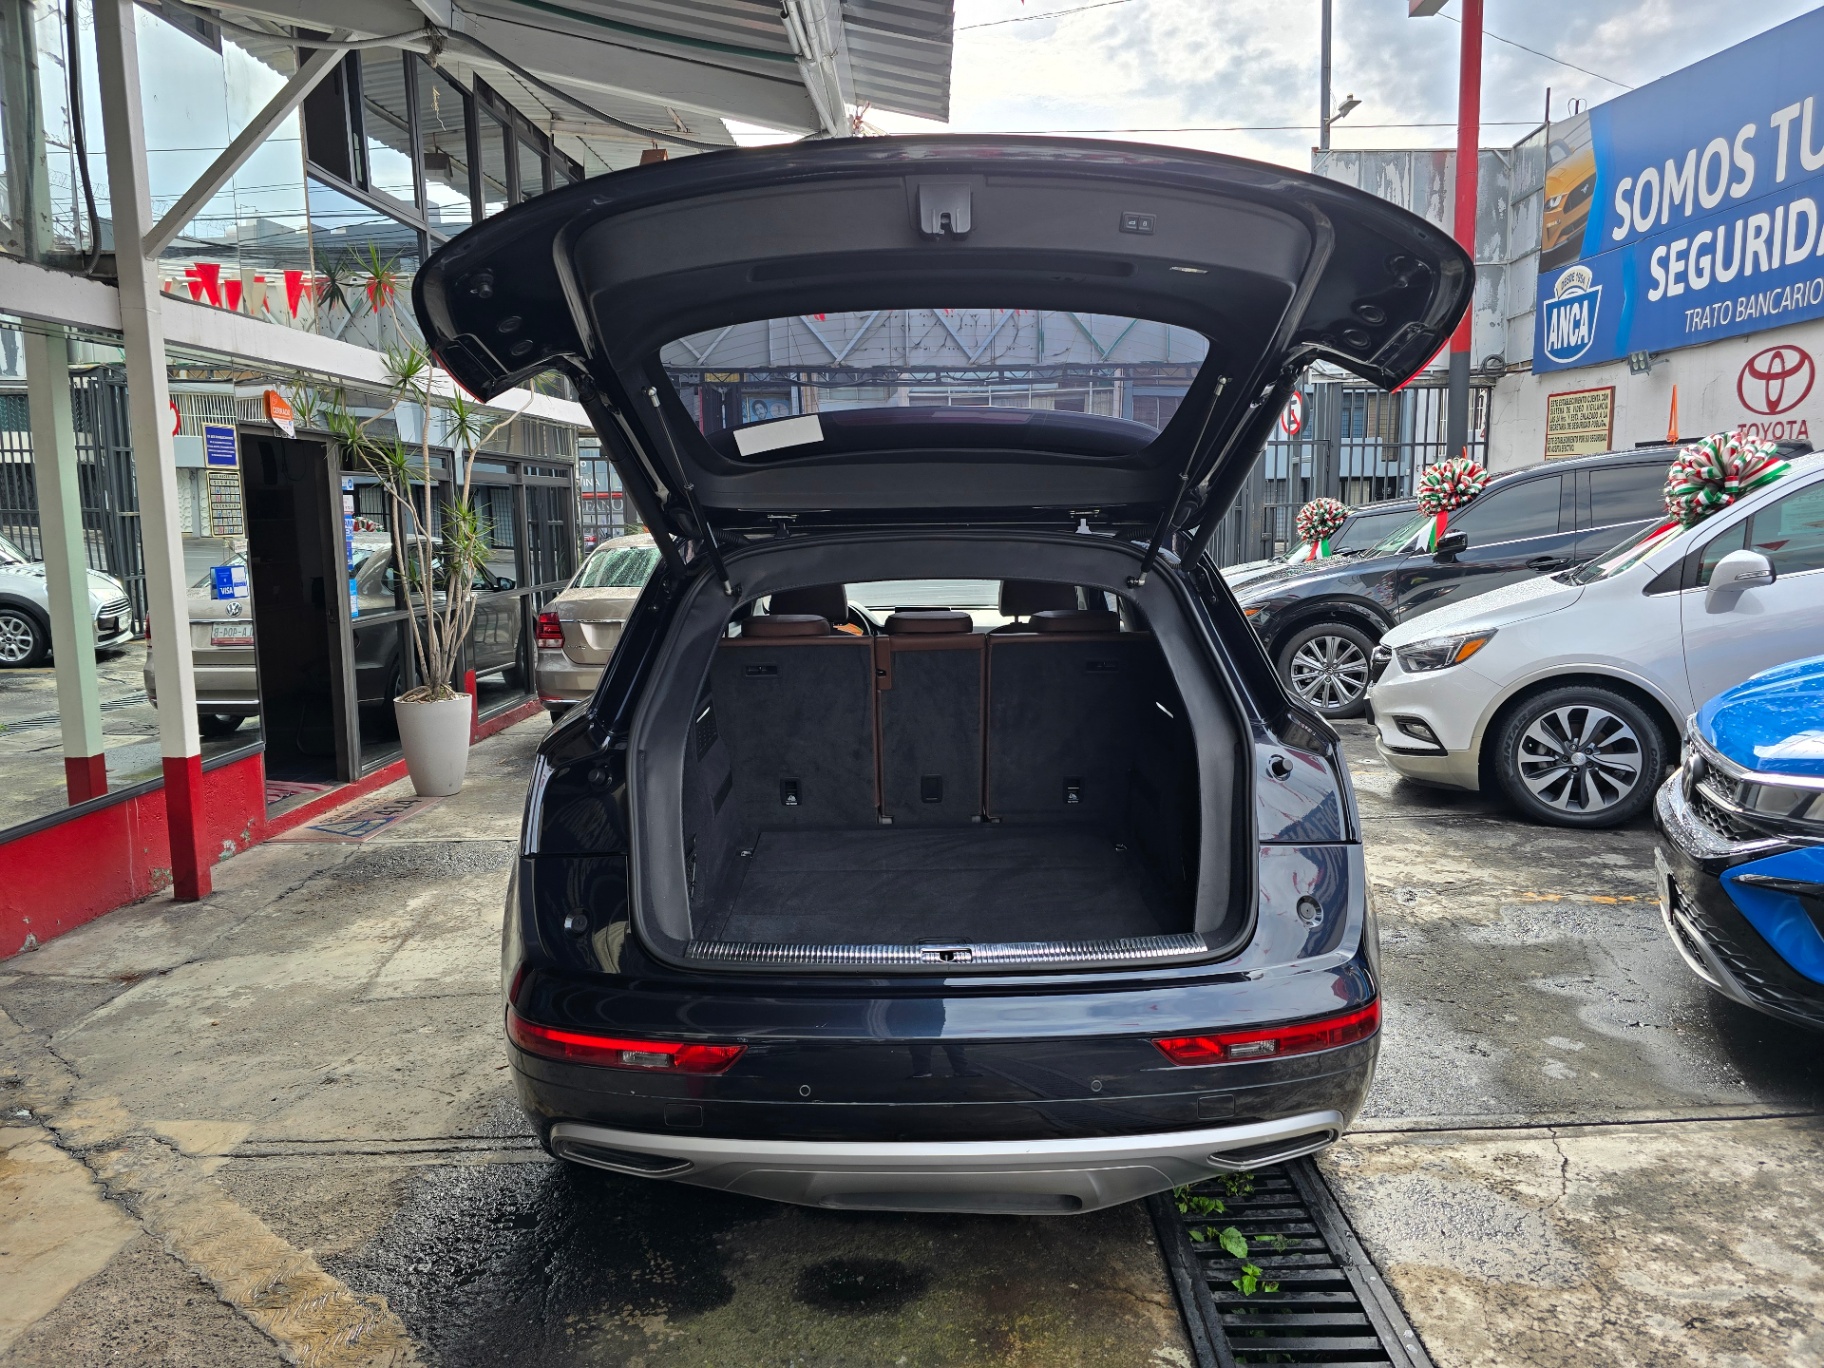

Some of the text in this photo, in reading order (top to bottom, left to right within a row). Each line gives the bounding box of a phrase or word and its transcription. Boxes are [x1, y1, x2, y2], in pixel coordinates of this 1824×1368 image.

[1612, 97, 1824, 241] SOMOS TU
[1648, 198, 1824, 301] SEGURID
[1548, 300, 1589, 350] ANCA
[1685, 278, 1824, 333] TRATO BANCARIO
[1737, 420, 1809, 441] TOYOTA
[220, 586, 233, 595] VISA
